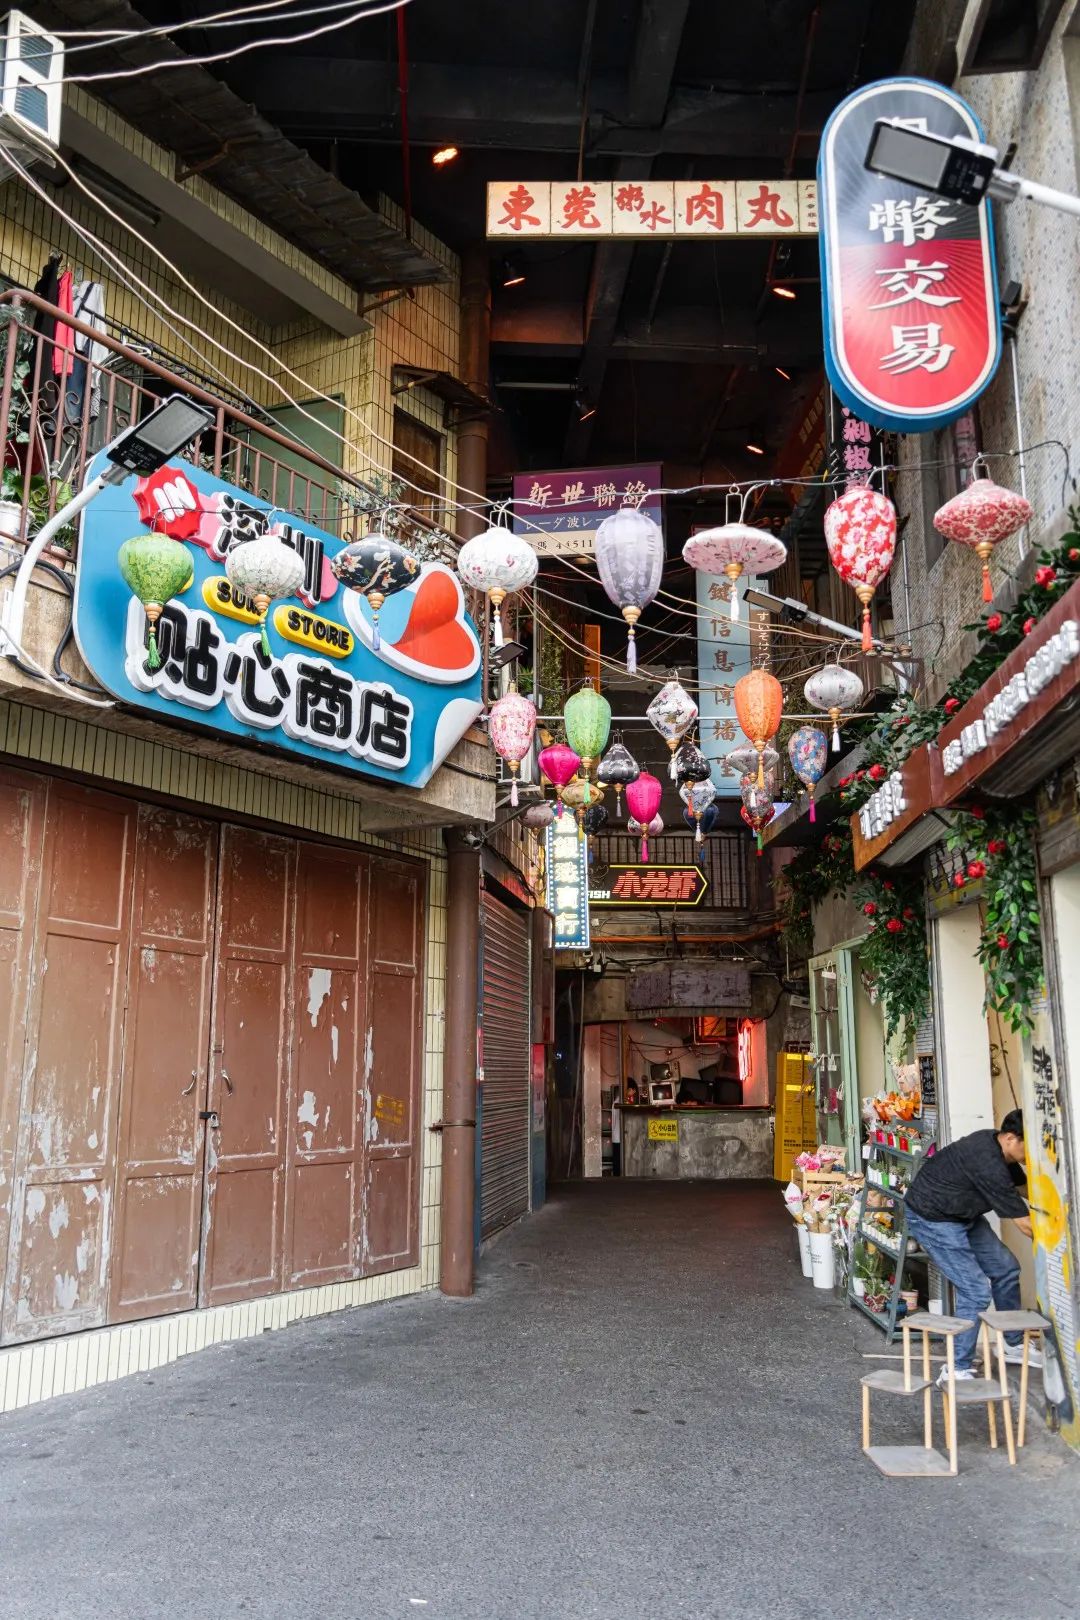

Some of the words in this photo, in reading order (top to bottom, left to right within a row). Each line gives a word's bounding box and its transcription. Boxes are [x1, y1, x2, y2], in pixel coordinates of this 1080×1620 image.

[867, 115, 962, 375] 幣交易
[153, 476, 197, 523] IN
[529, 481, 648, 508] 新世聯絡
[287, 608, 350, 651] STORE
[142, 602, 410, 760] 贴心商店
[611, 871, 697, 899] 小龙虾
